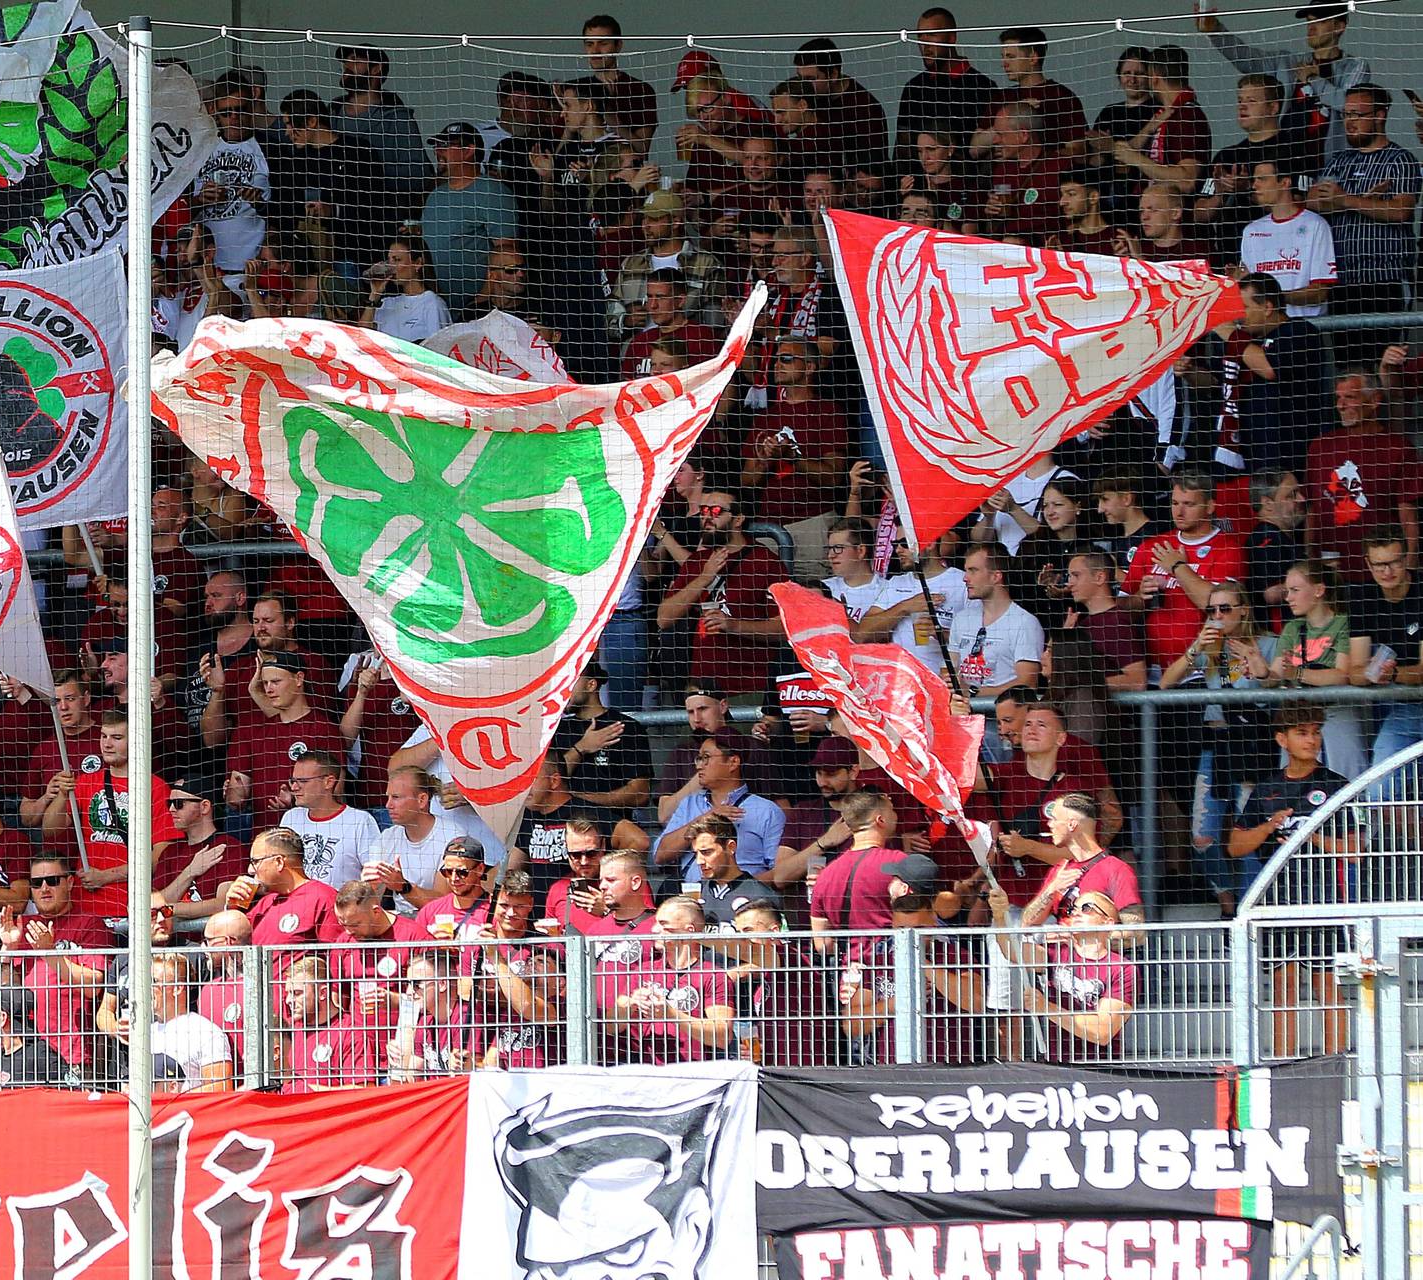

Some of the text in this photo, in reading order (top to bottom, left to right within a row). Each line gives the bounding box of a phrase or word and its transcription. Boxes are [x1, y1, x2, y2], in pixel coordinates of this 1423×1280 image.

[780, 685, 827, 701] elless
[869, 1081, 1160, 1130] Rebellion
[755, 1126, 1310, 1193] OBERHAUSEN
[794, 1218, 1252, 1280] FANATISCHE
